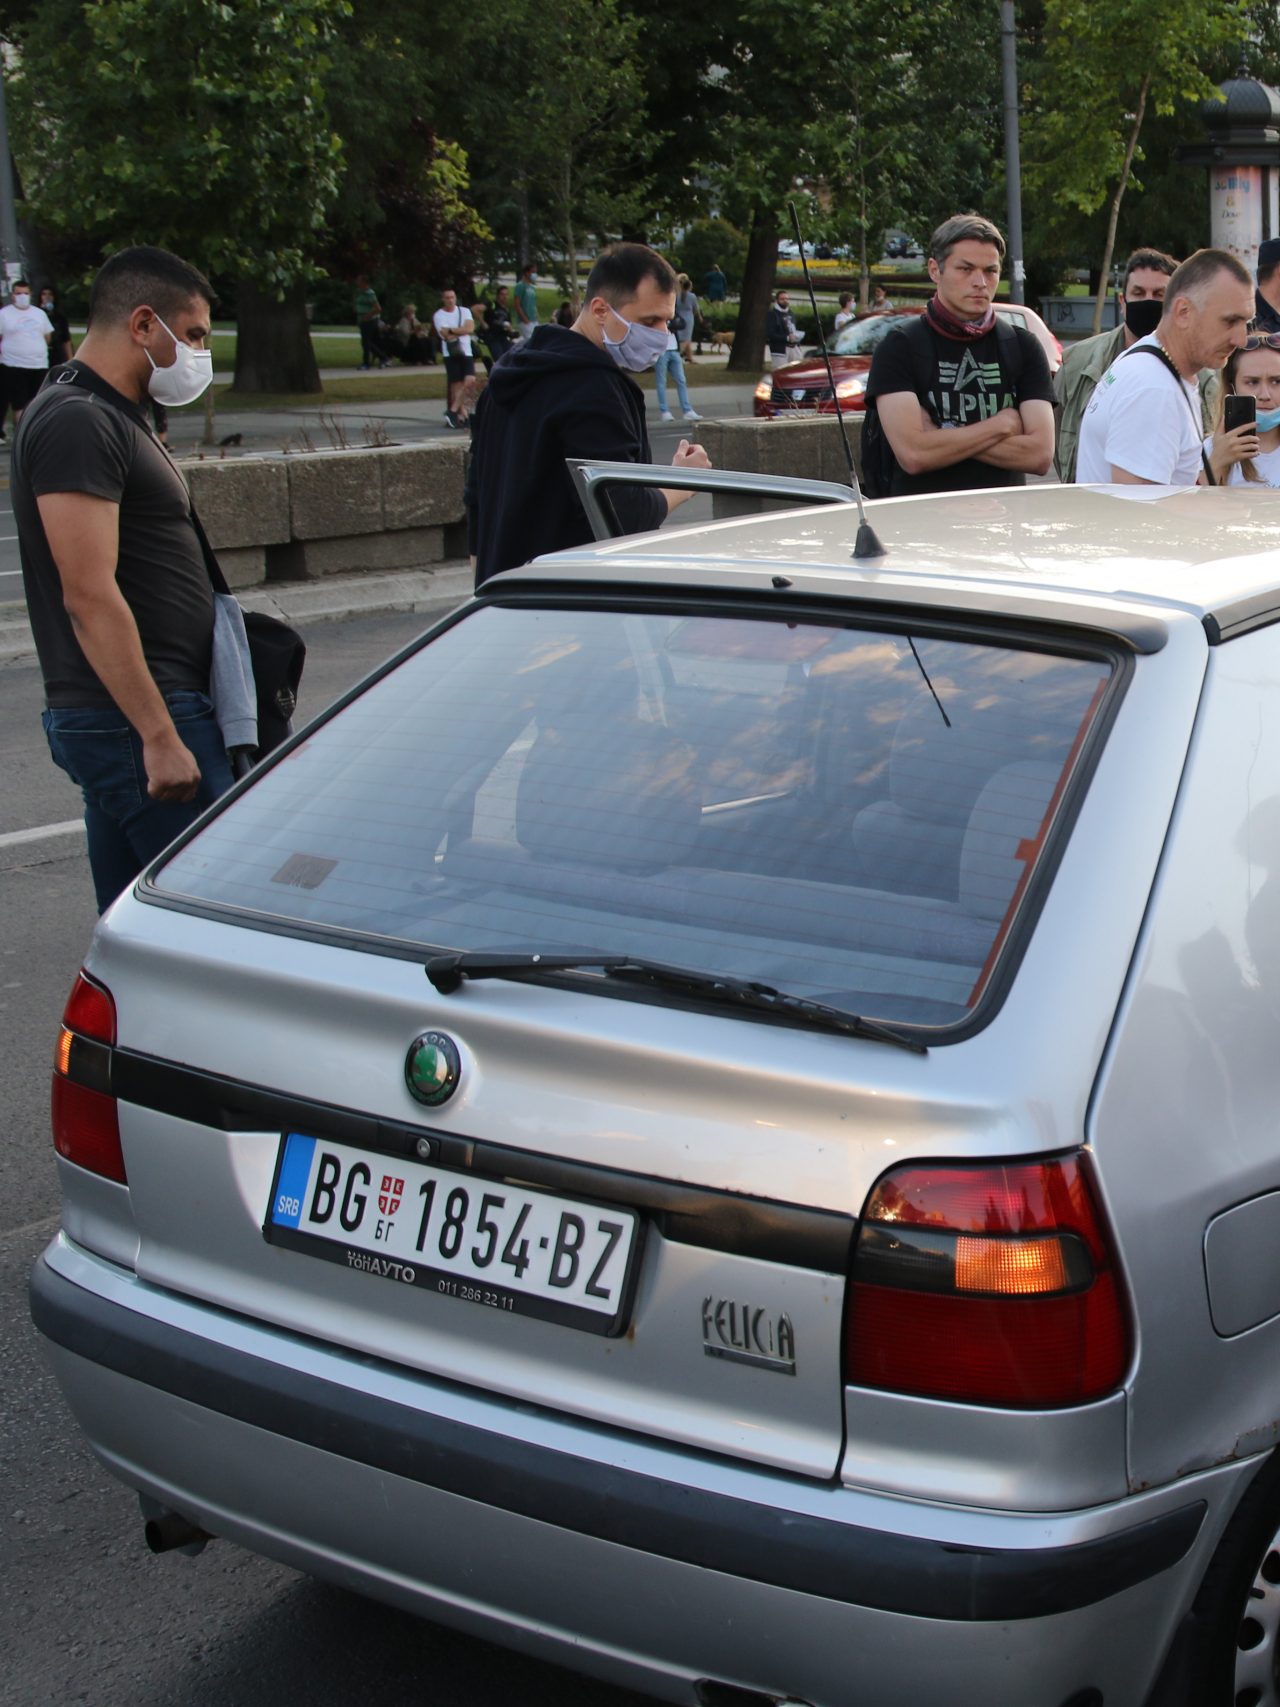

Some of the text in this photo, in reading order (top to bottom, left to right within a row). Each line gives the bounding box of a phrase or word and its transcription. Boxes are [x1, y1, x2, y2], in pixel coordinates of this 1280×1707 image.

[277, 1194, 300, 1217] SRB
[308, 1151, 372, 1233] BG
[374, 1219, 395, 1243] БГ
[438, 1279, 514, 1311] 011 286 22 11
[701, 1295, 796, 1360] FELICIA
